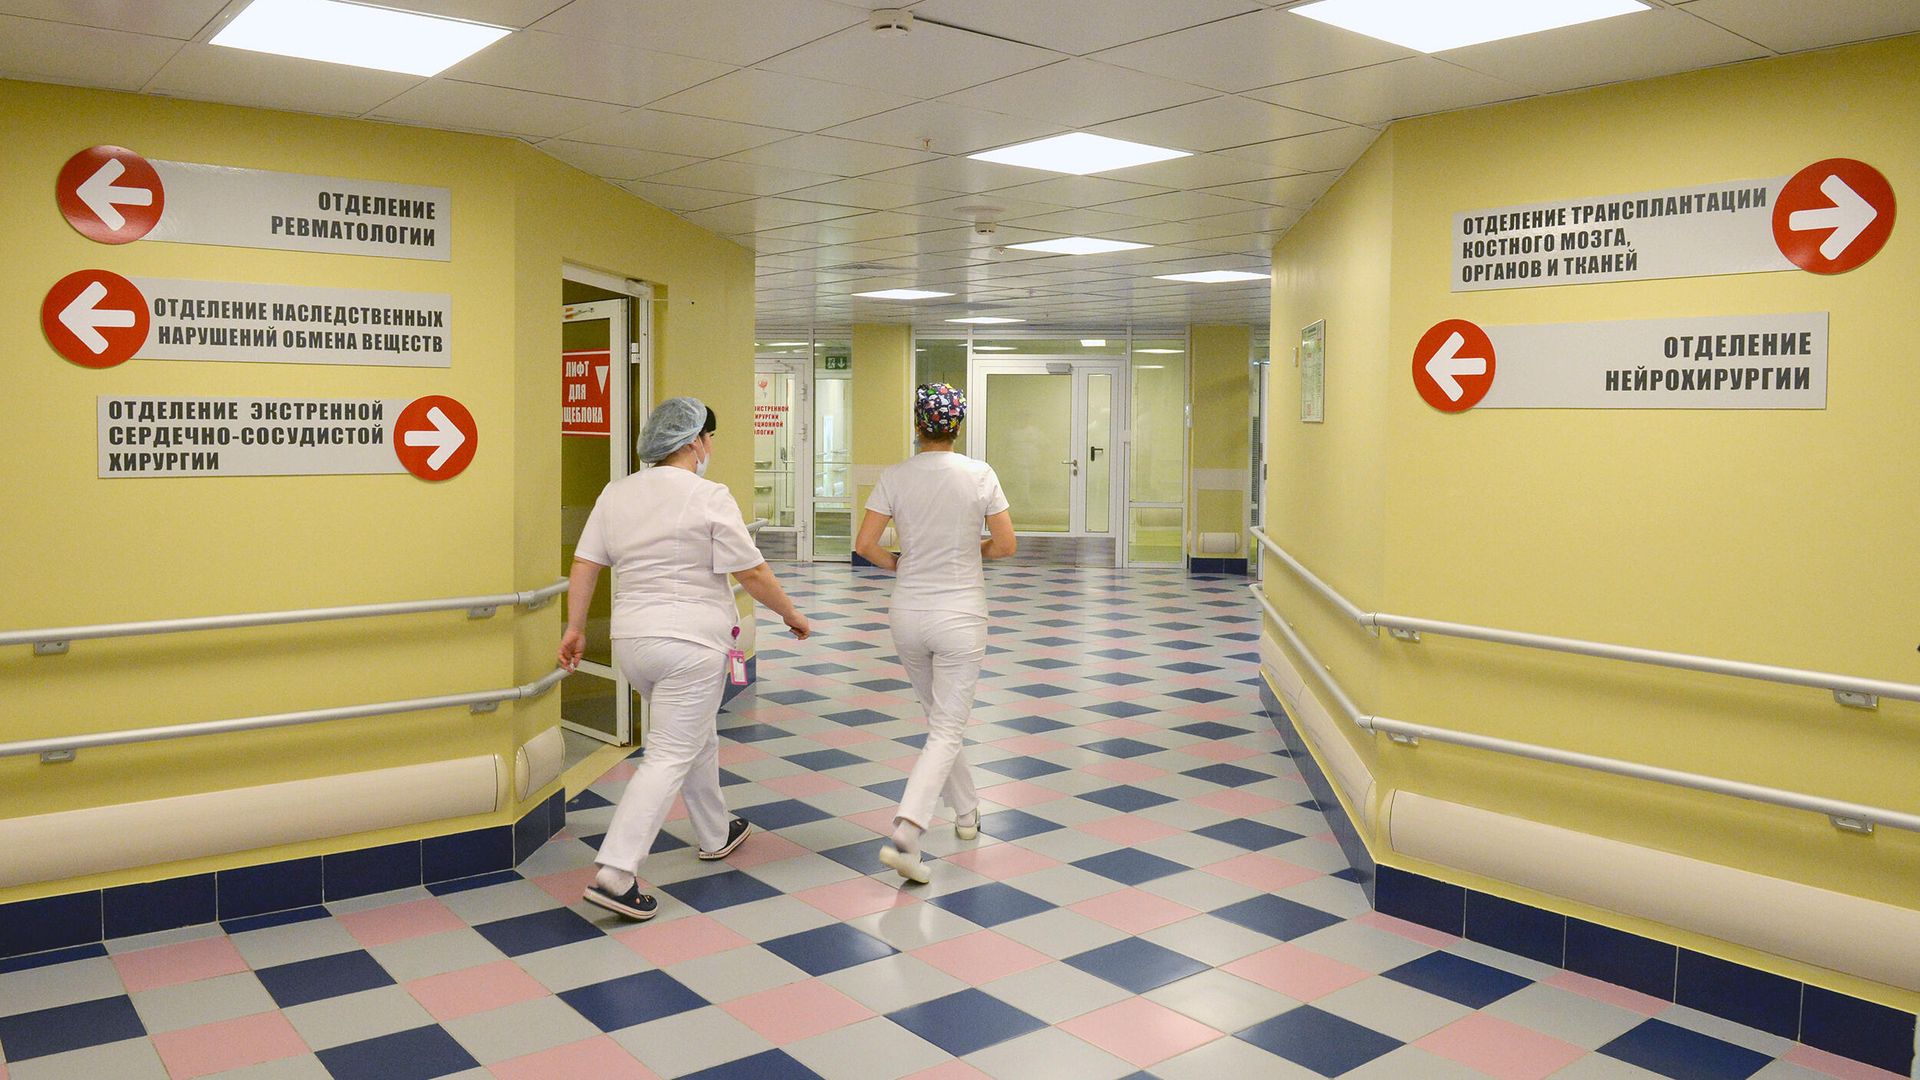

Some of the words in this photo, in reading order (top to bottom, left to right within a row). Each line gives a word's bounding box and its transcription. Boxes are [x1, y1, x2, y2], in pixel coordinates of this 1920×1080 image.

[318, 191, 436, 220] ОТДЕЛЕНИЕ
[1462, 209, 1567, 233] ОТДЕЛЕНИЕ
[1571, 187, 1768, 226] ТРАНСПЛАНТАЦИИ
[271, 215, 436, 247] РЕВМАТОЛОГИИ
[1462, 234, 1556, 259] КОСТНОГО
[1561, 228, 1633, 251] МОЗГА,
[1461, 260, 1543, 283] ОРГАНОВ
[1547, 258, 1559, 276] И
[1564, 249, 1638, 275] ТКАНЕЙ
[153, 297, 268, 321] ОТДЕЛЕНИЕ
[272, 303, 444, 328] НАСЛЕДСТВЕННЫХ
[158, 325, 278, 348] НАРУШЕНИЙ
[282, 330, 358, 350] ОБМЕНА
[361, 333, 443, 354] ВЕЩЕСТВ
[1664, 332, 1812, 360] ОТДЕЛЕНИЕ
[565, 361, 589, 377] ЛИФТ
[1605, 366, 1811, 391] НЕЙРОХИРУРГИИ
[569, 384, 586, 402] ДЛЯ
[108, 400, 239, 422] ОТДЕЛЕНИЕ
[250, 400, 384, 421] ЭКСТРЕННОЙ
[562, 407, 603, 424] ЩЕБЛОКА
[108, 425, 384, 447] СЕРДЕЧНО-СОСУДИСТОЙ
[108, 452, 219, 472] ХИРУРГИИ
